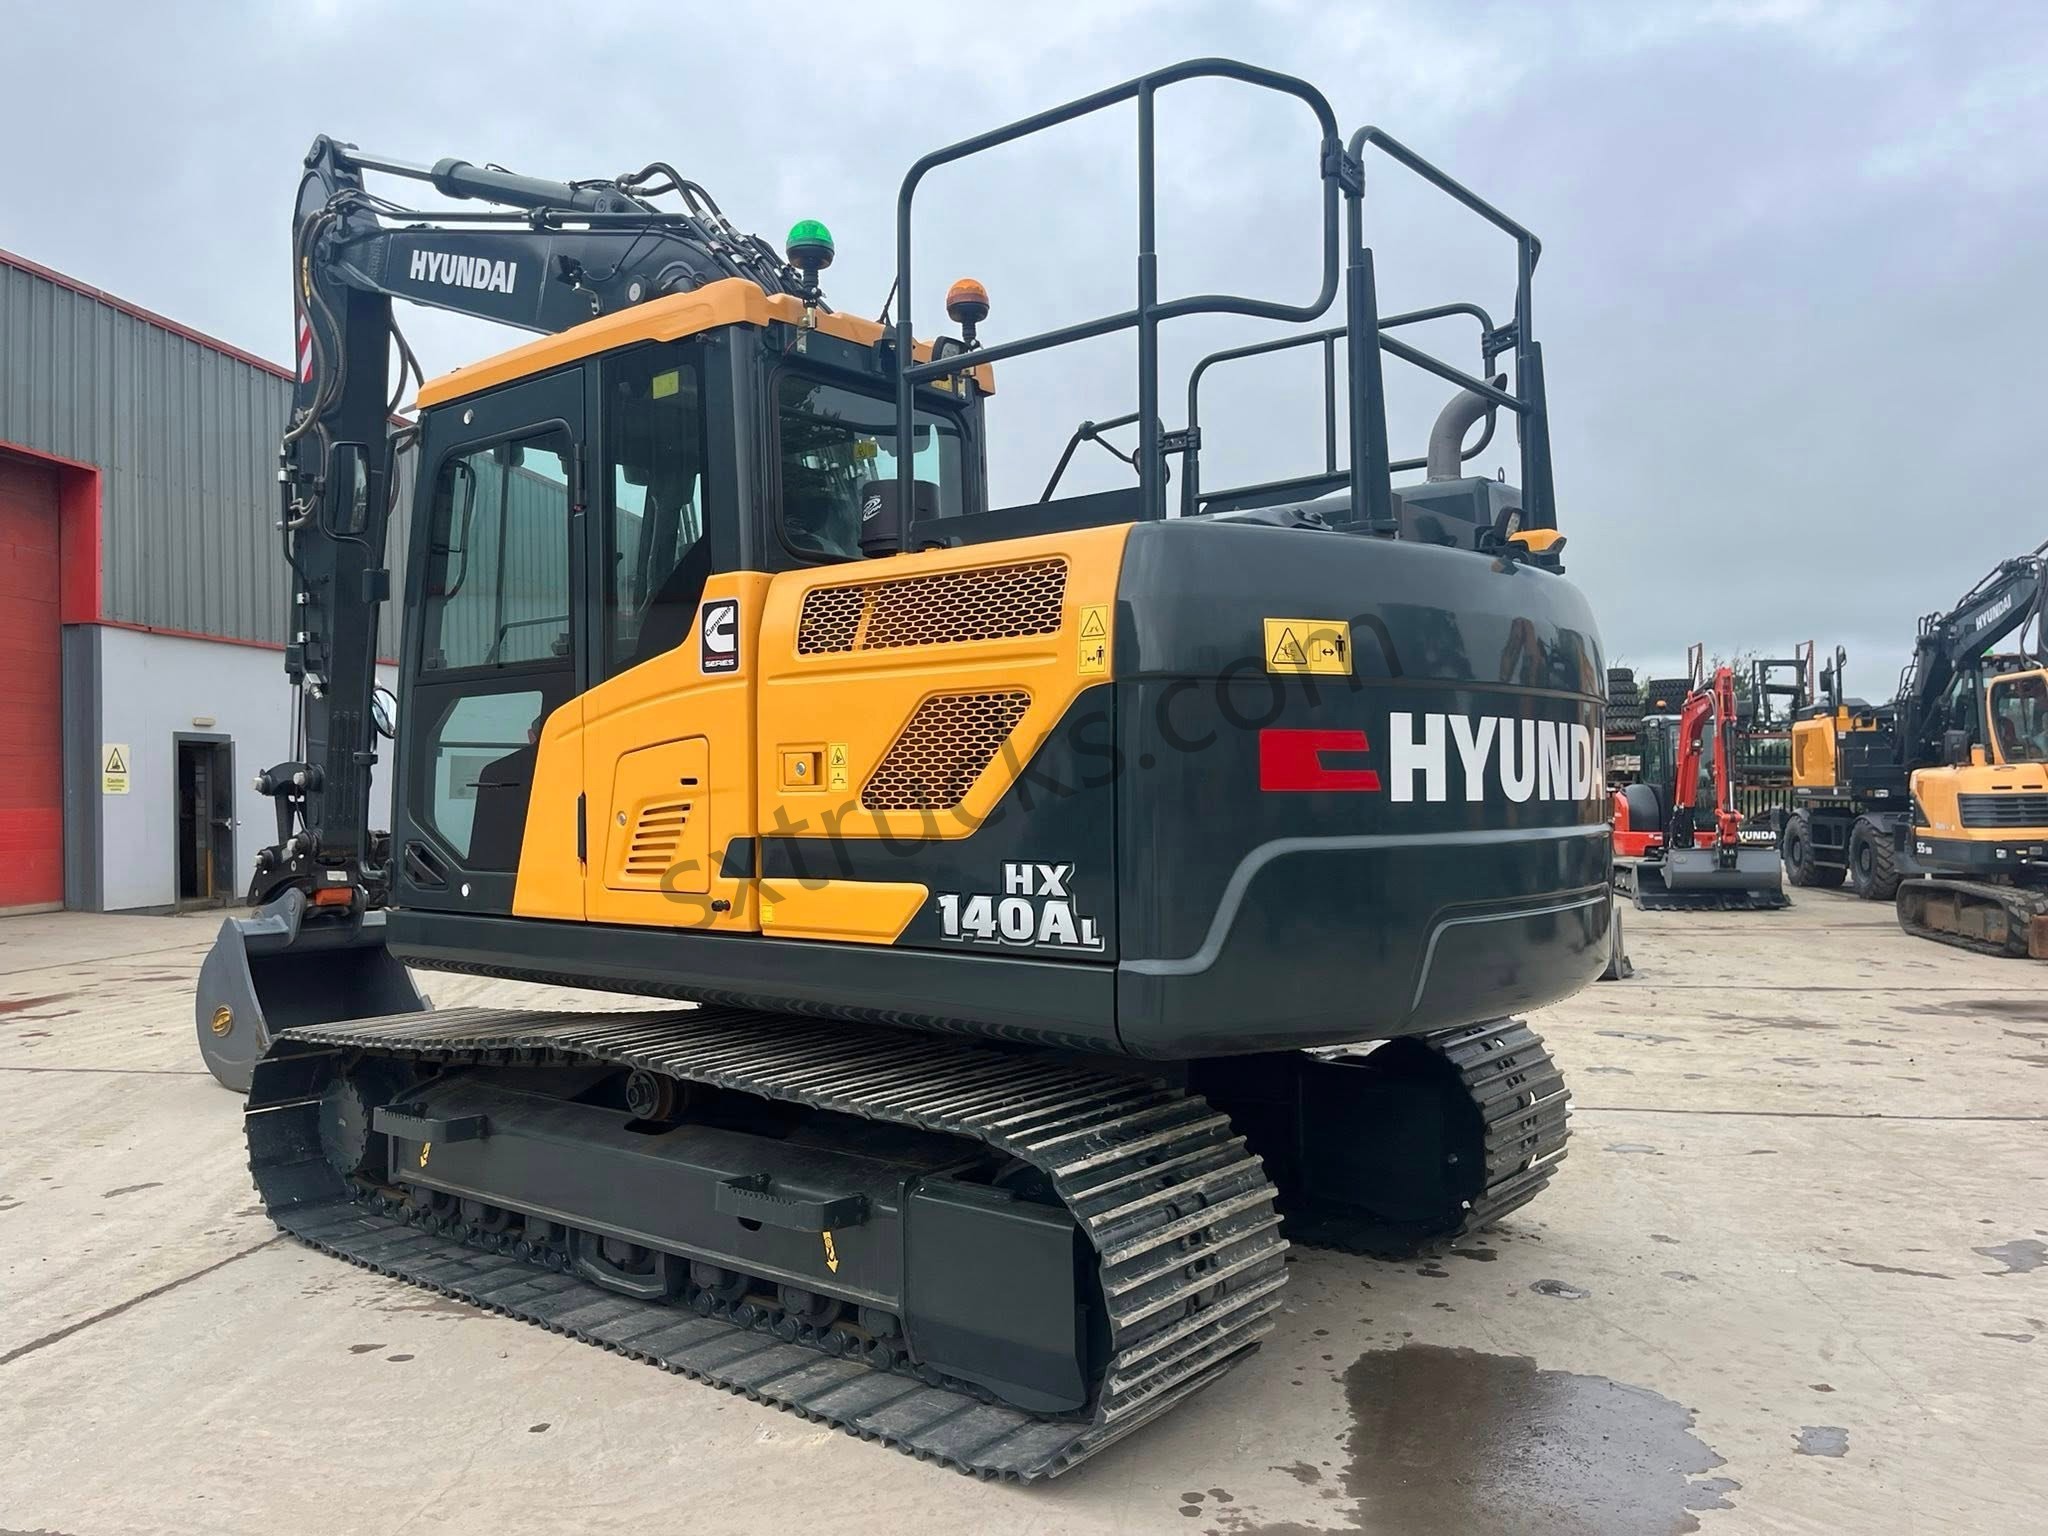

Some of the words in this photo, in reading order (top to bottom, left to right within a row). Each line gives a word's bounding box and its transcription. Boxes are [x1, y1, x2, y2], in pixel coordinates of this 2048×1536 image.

[410, 249, 517, 294] HYUNDAI
[705, 606, 732, 637] Cummins
[1975, 593, 2012, 631] HYUNDAI
[705, 659, 735, 668] SERIES
[1004, 863, 1070, 897] HX
